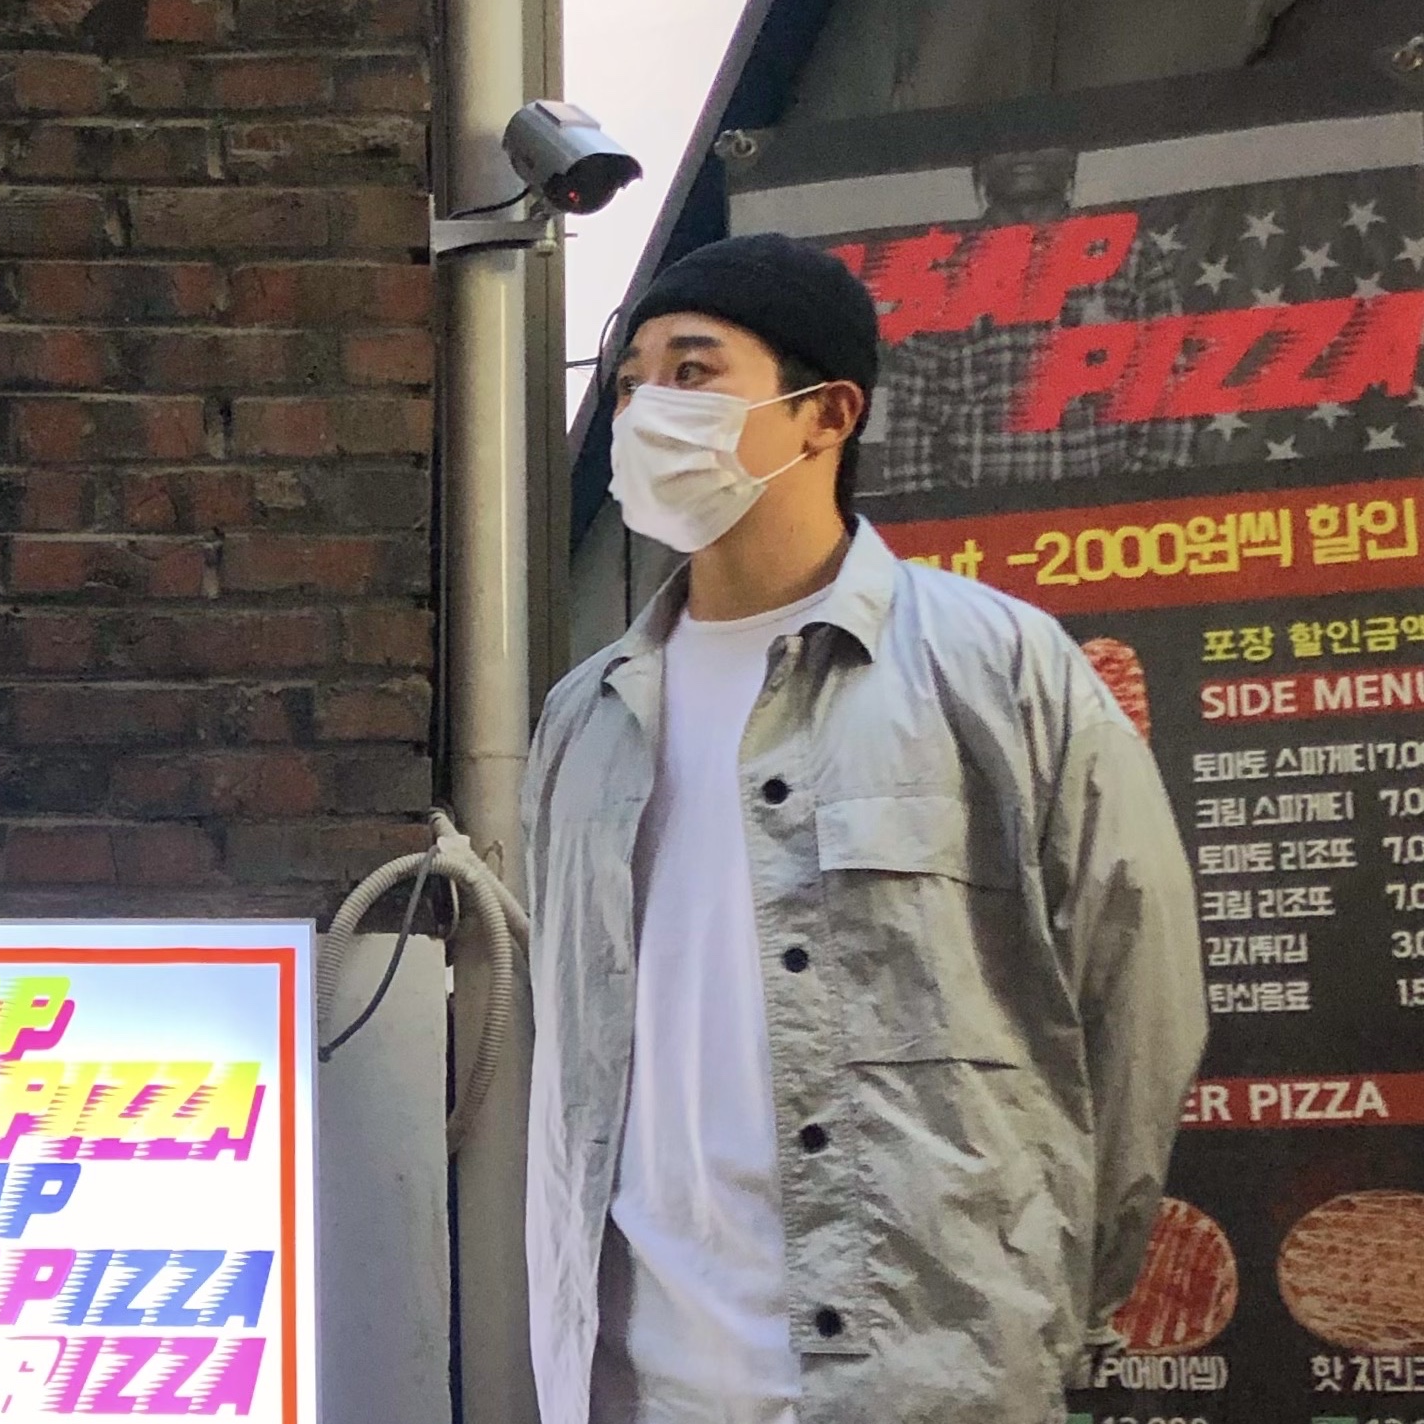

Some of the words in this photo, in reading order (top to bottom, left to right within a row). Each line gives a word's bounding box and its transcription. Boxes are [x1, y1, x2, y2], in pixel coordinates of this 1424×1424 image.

[828, 212, 1139, 345] $AP
[1004, 290, 1424, 433] PIZZA
[1007, 508, 1293, 586] -2000원씩
[1305, 498, 1419, 565] 할인
[1202, 626, 1274, 661] 포장
[1200, 680, 1297, 719] SIDE
[1193, 749, 1269, 783] 토마토
[1276, 742, 1376, 777] 스파게티
[1196, 799, 1245, 828] 크림
[1253, 791, 1354, 825] 스파게티
[1198, 844, 1275, 875] 토마토
[1280, 837, 1358, 870] 리조또
[1201, 891, 1252, 922] 크림
[1258, 885, 1336, 917] 리조또
[1205, 934, 1308, 967] 감자튀김
[1208, 980, 1311, 1014] 탄산음료
[1248, 1081, 1389, 1121] PIZZA
[46, 1249, 275, 1328] IZZA
[1310, 1355, 1345, 1392] 핫
